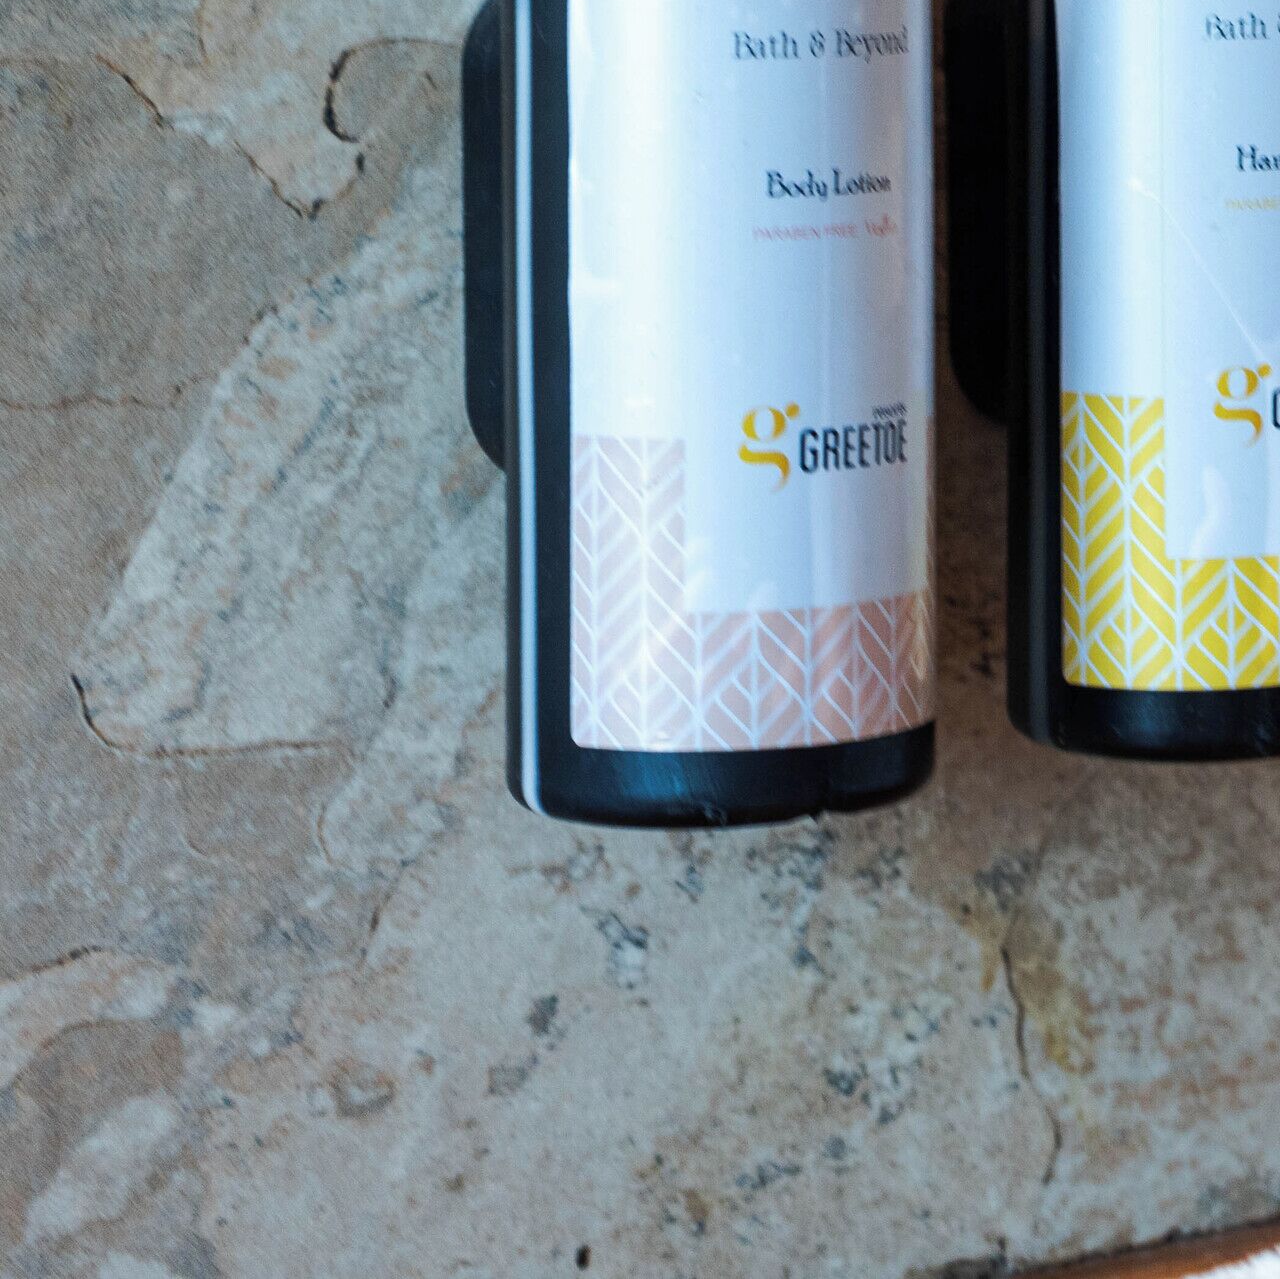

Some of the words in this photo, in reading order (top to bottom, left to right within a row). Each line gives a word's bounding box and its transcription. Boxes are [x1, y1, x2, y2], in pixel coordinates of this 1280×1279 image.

[734, 29, 800, 60] Bath
[834, 23, 909, 65] Beyond
[1205, 11, 1269, 40] Bath
[766, 170, 828, 202] Body
[832, 167, 892, 196] Lotion
[800, 419, 908, 474] GREETOE
